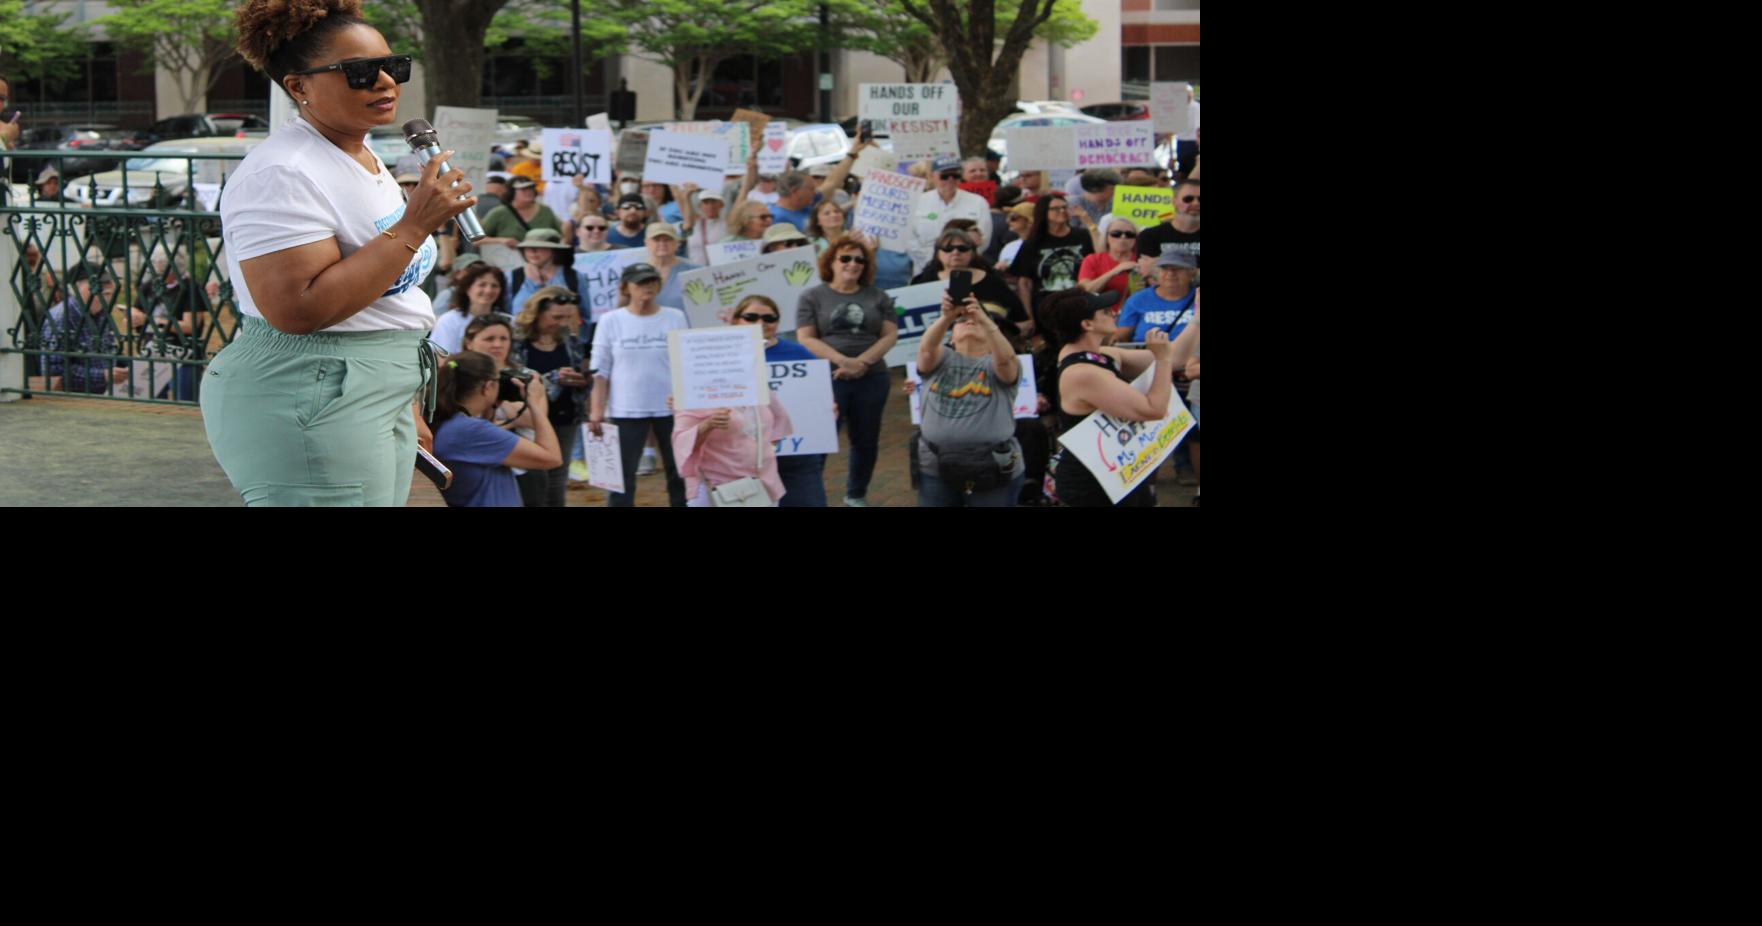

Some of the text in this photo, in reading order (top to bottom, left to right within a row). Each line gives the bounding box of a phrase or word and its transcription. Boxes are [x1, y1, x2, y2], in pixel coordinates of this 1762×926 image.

[869, 85, 945, 99] HANDS OFF
[892, 102, 920, 116] OUR
[1079, 138, 1121, 148] HANDS
[552, 151, 601, 180] RESIST
[1121, 193, 1171, 205] HANDS
[1131, 208, 1160, 219] OFF
